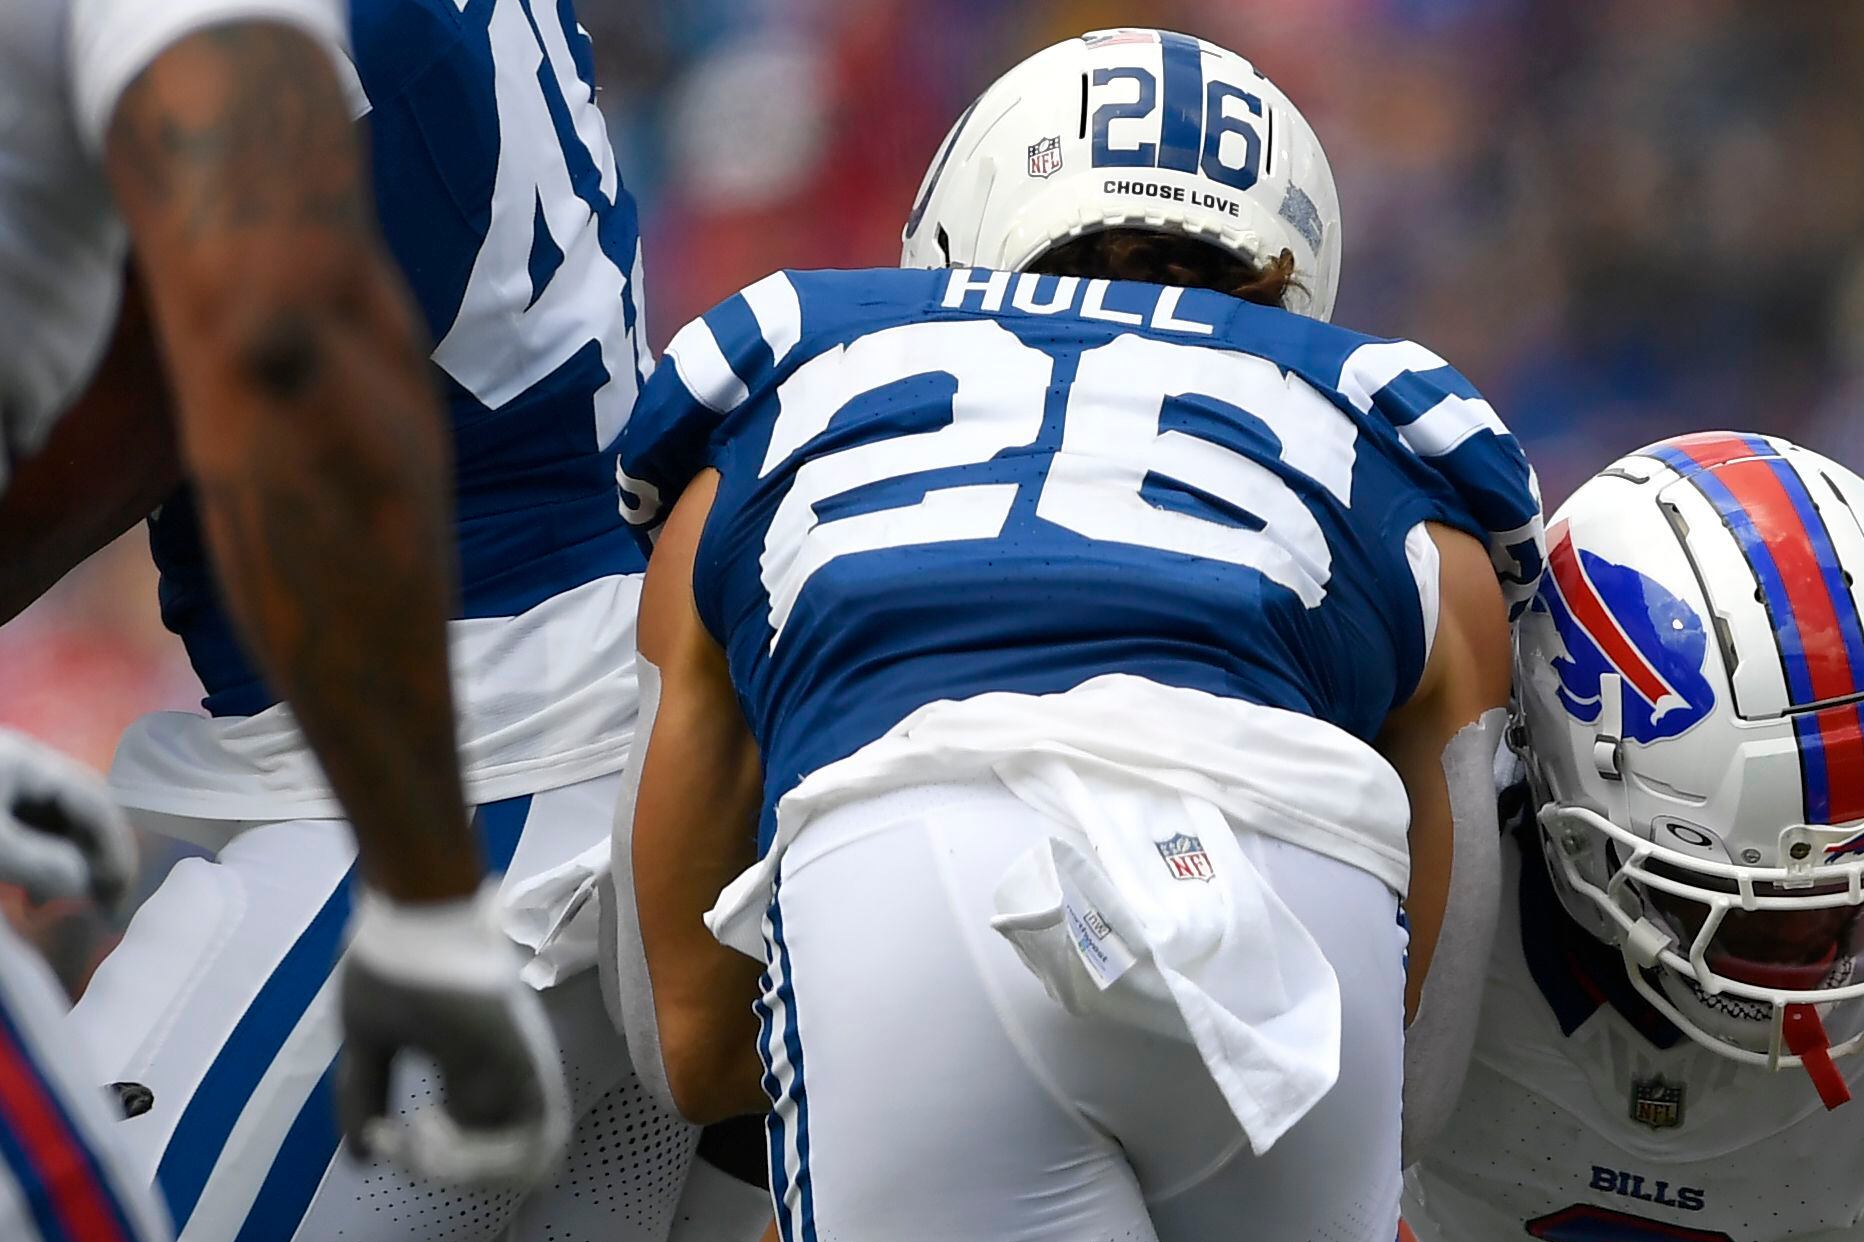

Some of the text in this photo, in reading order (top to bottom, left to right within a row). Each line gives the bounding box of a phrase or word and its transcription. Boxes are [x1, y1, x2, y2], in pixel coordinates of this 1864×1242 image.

[1091, 66, 1263, 191] 26
[1031, 151, 1060, 174] NFL
[1103, 180, 1240, 218] CHOOSE LOVE
[941, 268, 1214, 335] HULL
[758, 318, 1360, 657] 26
[1639, 1102, 1675, 1123] NFL
[1590, 1165, 1705, 1212] BILLS
